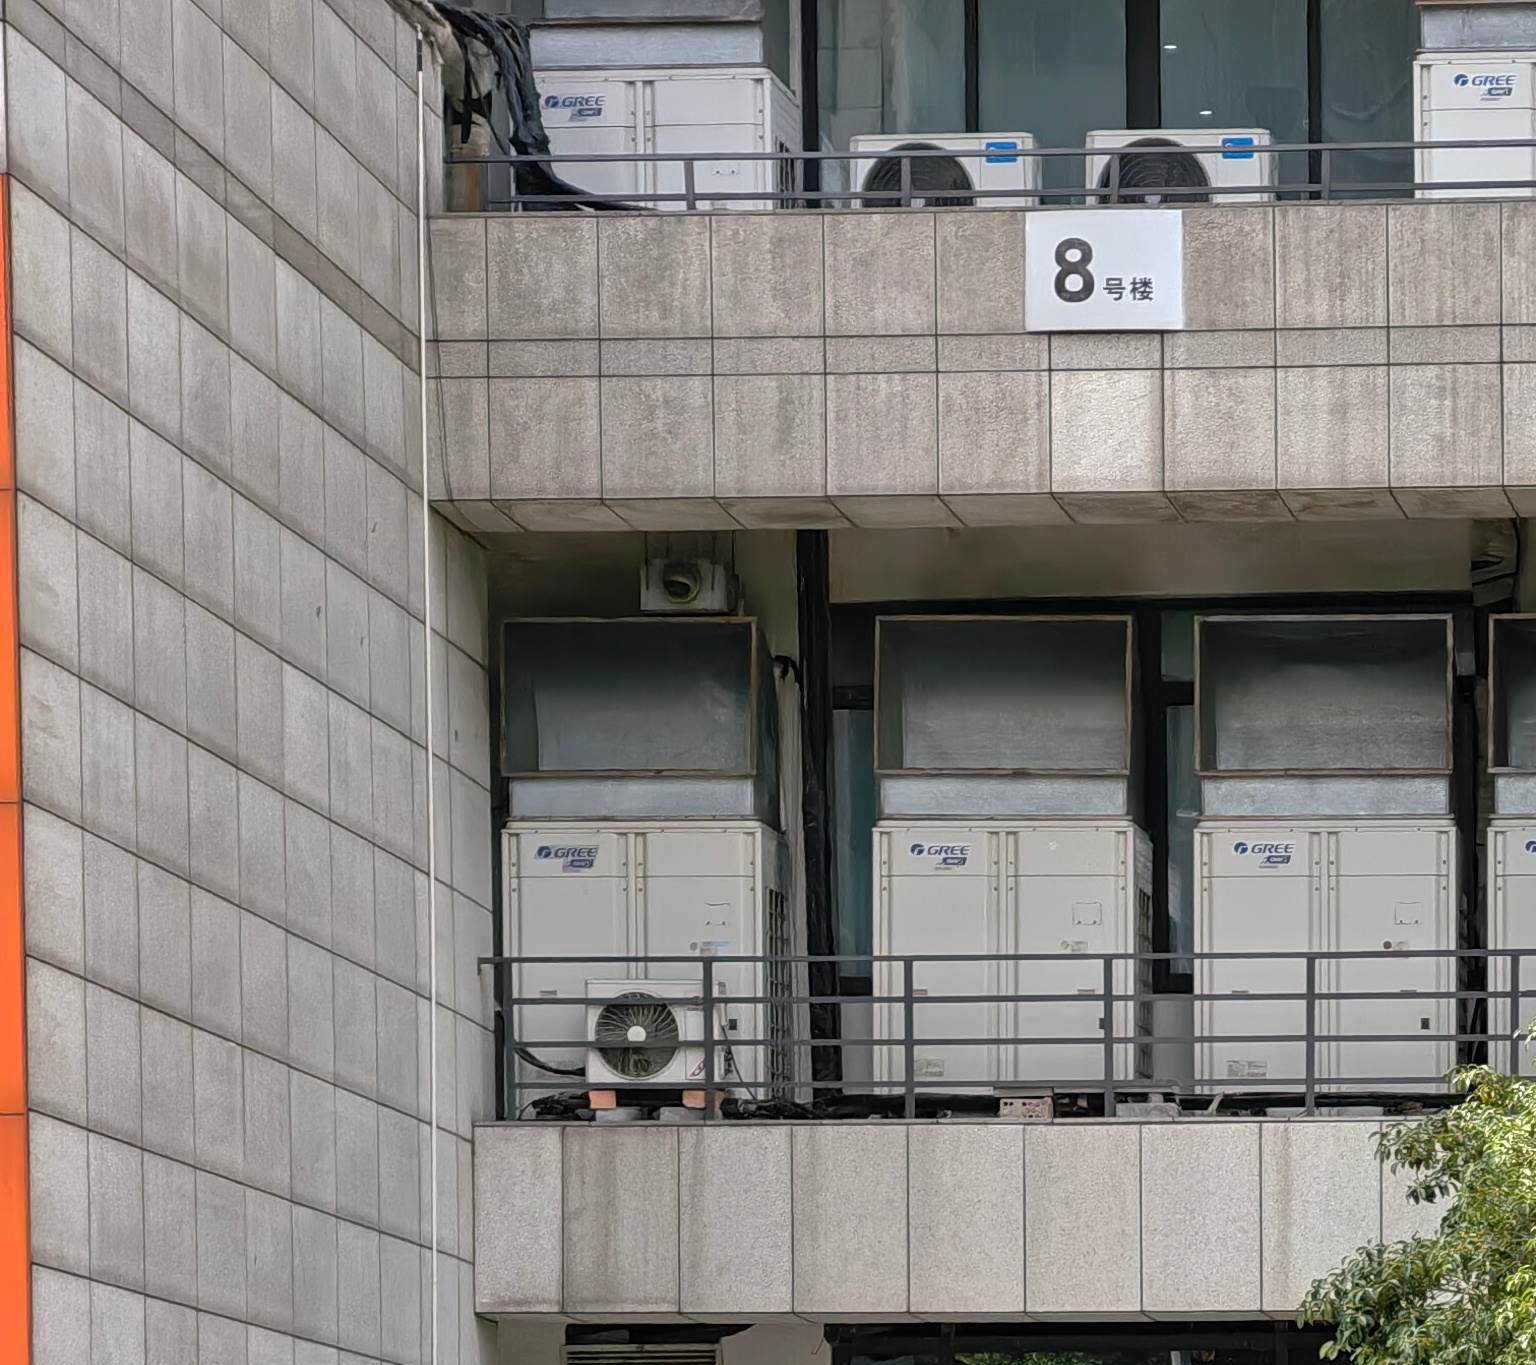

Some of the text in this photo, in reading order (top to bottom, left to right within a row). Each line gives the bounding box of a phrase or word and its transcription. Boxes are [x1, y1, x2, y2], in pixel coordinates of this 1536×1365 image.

[1471, 74, 1517, 86] GREE
[561, 95, 606, 108] GREE
[1054, 237, 1155, 303] 8号楼
[553, 847, 599, 858] GREE
[927, 845, 972, 856] GREE
[1251, 843, 1297, 854] GREE
